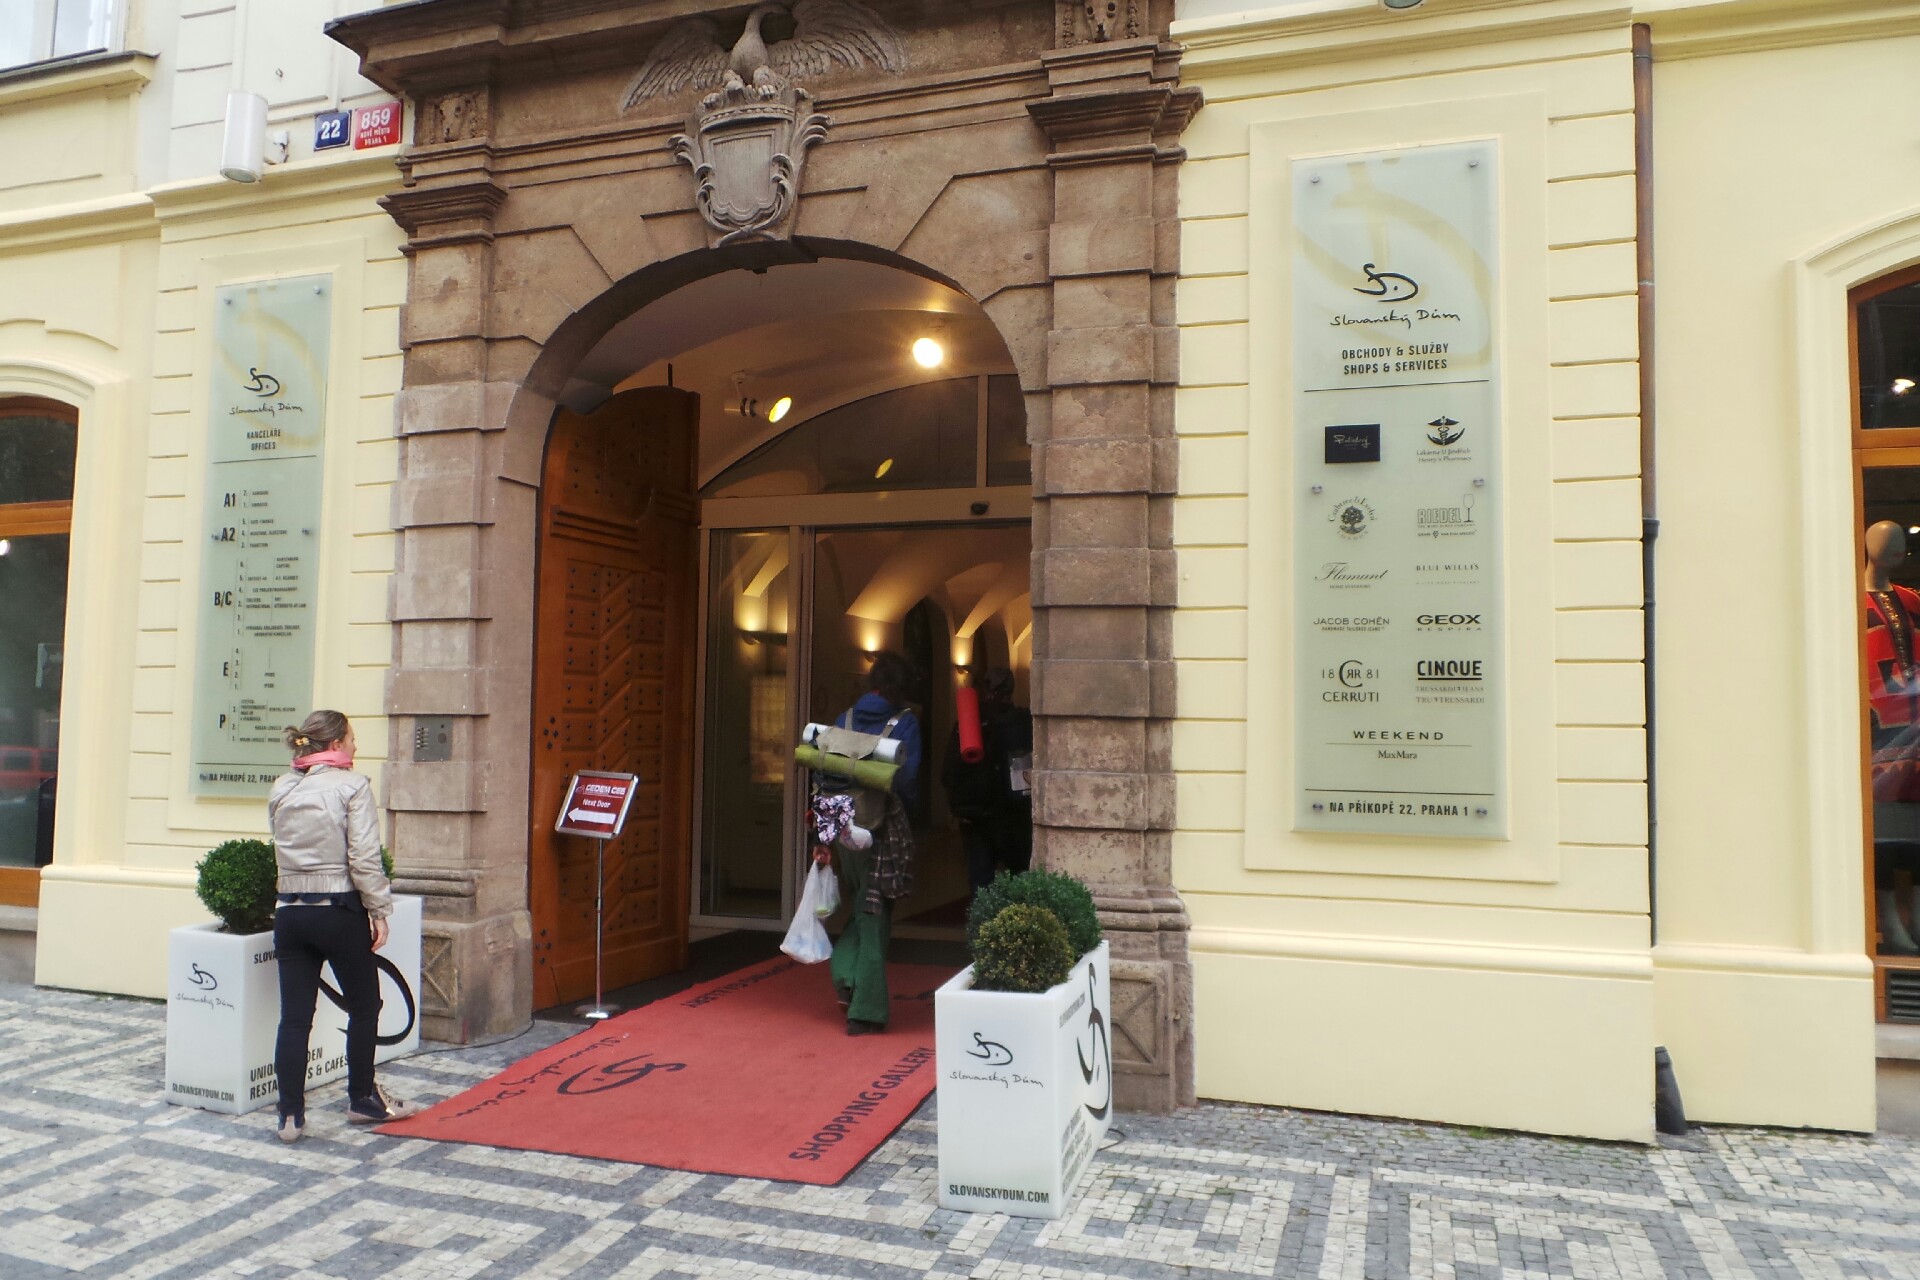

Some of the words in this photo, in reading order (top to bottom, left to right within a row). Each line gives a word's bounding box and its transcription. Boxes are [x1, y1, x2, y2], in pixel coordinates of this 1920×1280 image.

[361, 107, 391, 130] 859
[321, 119, 340, 140] 22
[364, 138, 382, 146] PRAHA
[1342, 346, 1392, 360] OBCHODY
[1396, 347, 1404, 356] &
[1408, 342, 1449, 356] SLUŽBY
[1344, 362, 1378, 375] SHOPS
[1383, 362, 1390, 372] &
[1395, 358, 1448, 372] SERVICES
[251, 442, 276, 451] OFFICES
[224, 492, 236, 507] A1
[1418, 508, 1462, 523] RIEDEL
[221, 527, 235, 542] A2
[1314, 562, 1388, 580] Flamant
[214, 590, 232, 608] B/C
[1416, 614, 1481, 625] GEOX
[223, 662, 228, 676] E
[1417, 660, 1482, 676] CINQUE
[1322, 691, 1379, 702] CERRUTI
[220, 714, 226, 729] P
[1353, 731, 1444, 740] WEEKEND
[1378, 750, 1417, 759] MaxMara
[597, 800, 611, 808] Door
[1330, 802, 1344, 813] NA
[1349, 800, 1394, 814] PŘÍKOPĚ
[1421, 804, 1458, 816] PRAHA
[1464, 806, 1468, 816] 1
[316, 1062, 322, 1076] &
[172, 1082, 234, 1102] SLOVANSKYDUM.COM
[789, 1091, 888, 1161] SHOPPING
[949, 1184, 1049, 1204] SLOVANSKYDUM.COM
